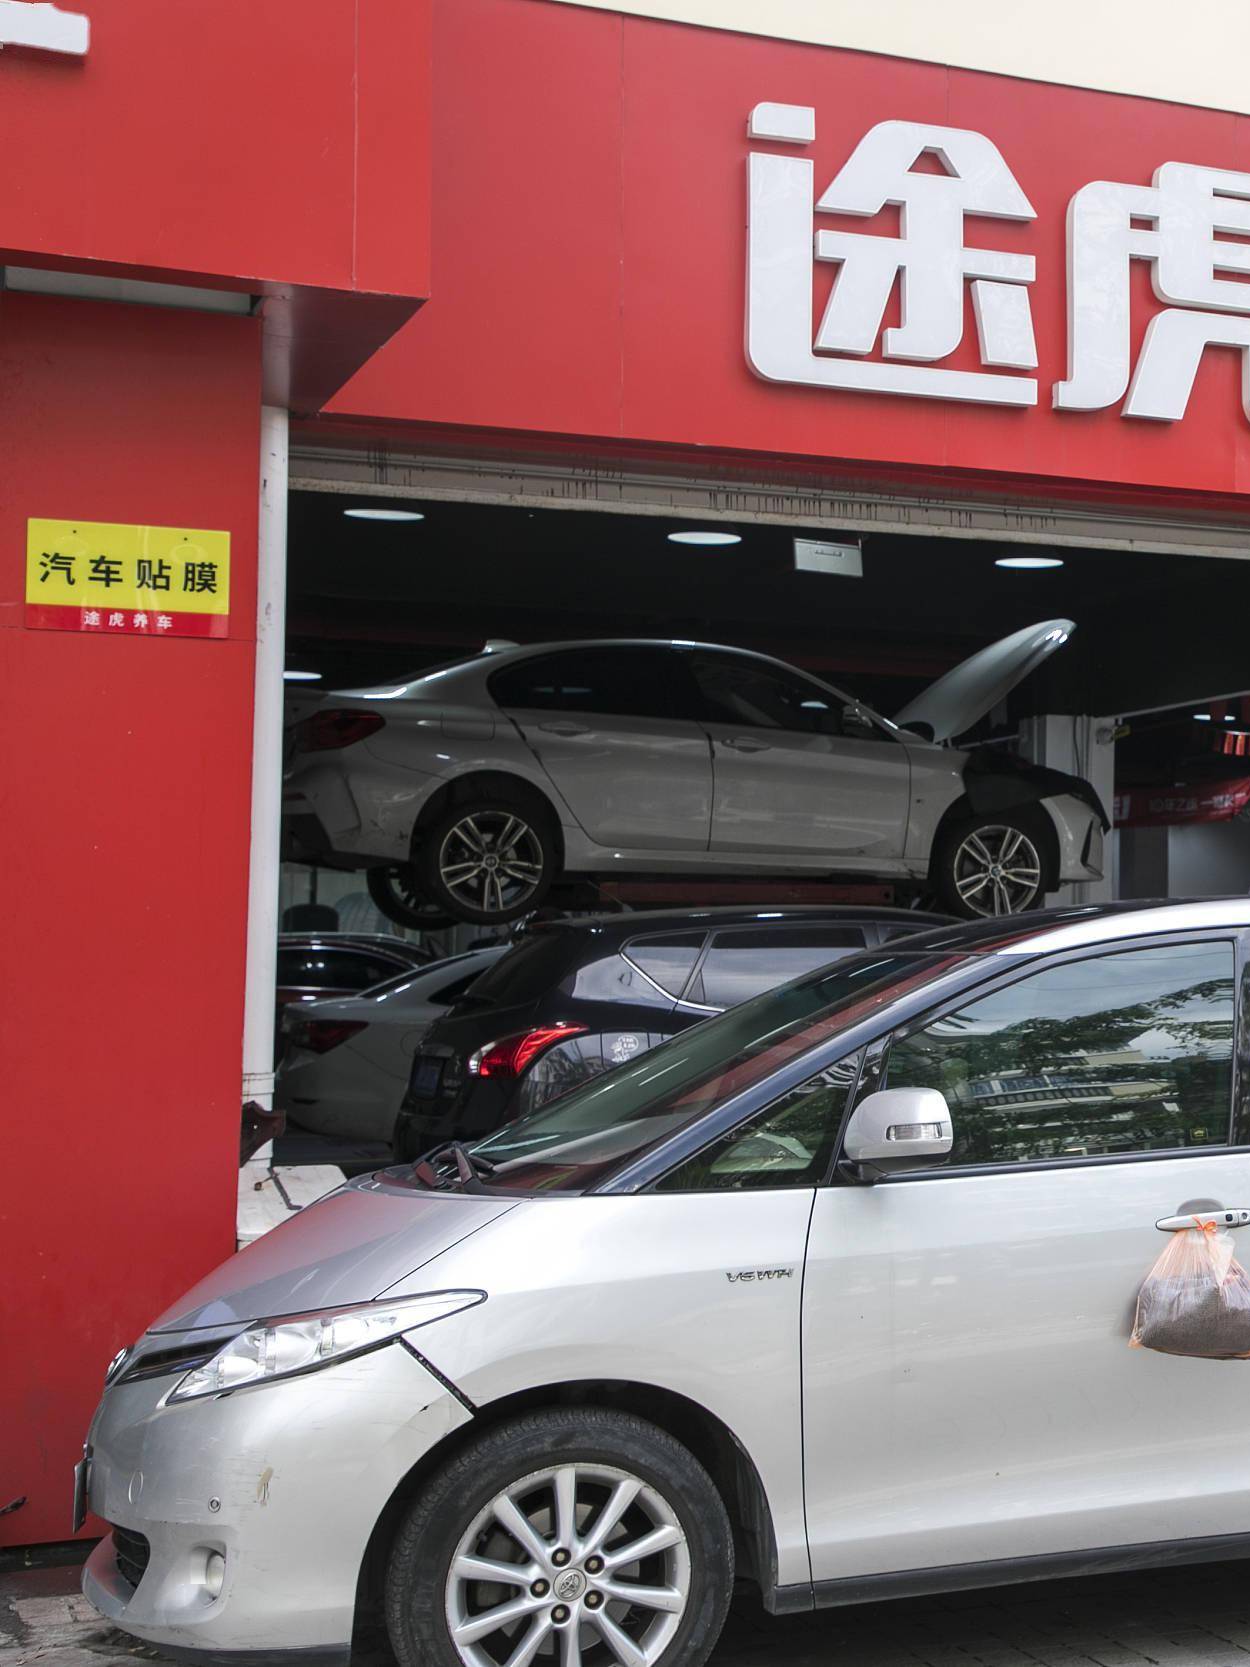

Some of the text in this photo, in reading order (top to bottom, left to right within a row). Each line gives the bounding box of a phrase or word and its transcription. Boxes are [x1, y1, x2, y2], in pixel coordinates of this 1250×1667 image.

[39, 552, 218, 594] 汽车贴膜
[83, 610, 173, 630] 途虎养车
